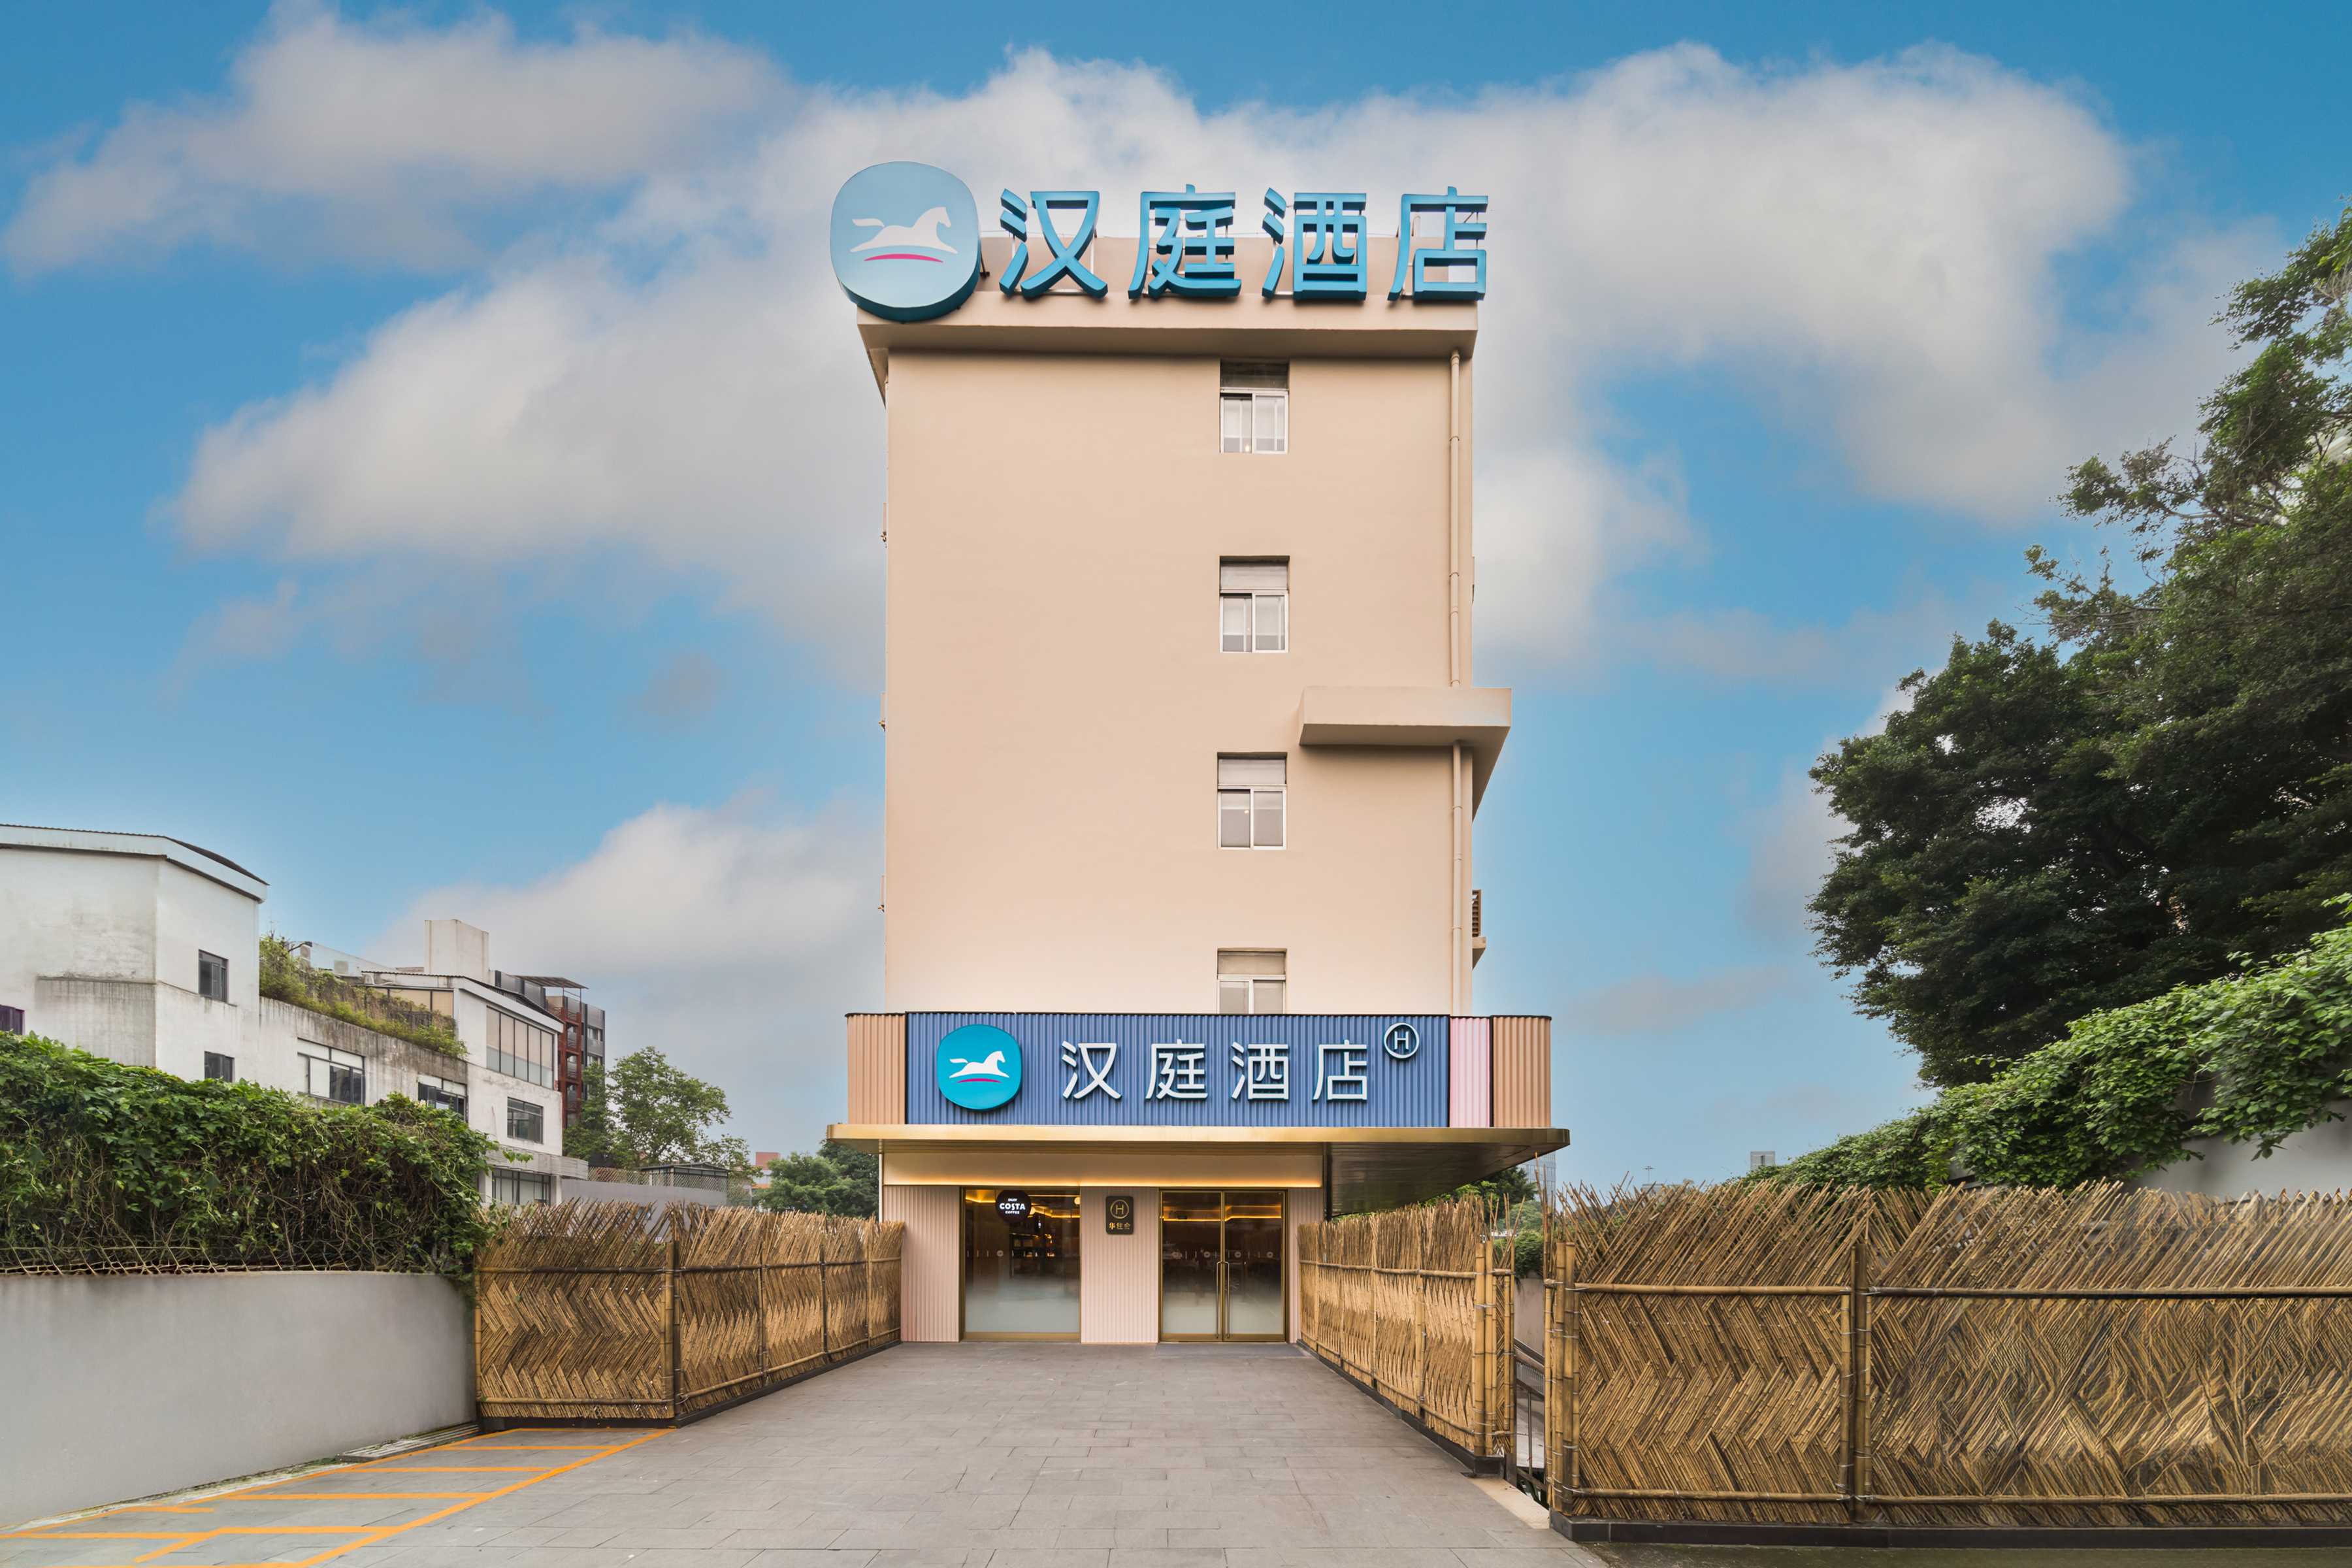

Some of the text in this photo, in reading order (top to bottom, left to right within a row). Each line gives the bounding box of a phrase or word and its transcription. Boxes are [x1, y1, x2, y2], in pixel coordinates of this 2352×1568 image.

[999, 184, 1489, 301] 汉庭酒店
[1061, 1039, 1369, 1101] 汉庭酒店
[1109, 1222, 1131, 1230] 华住会
